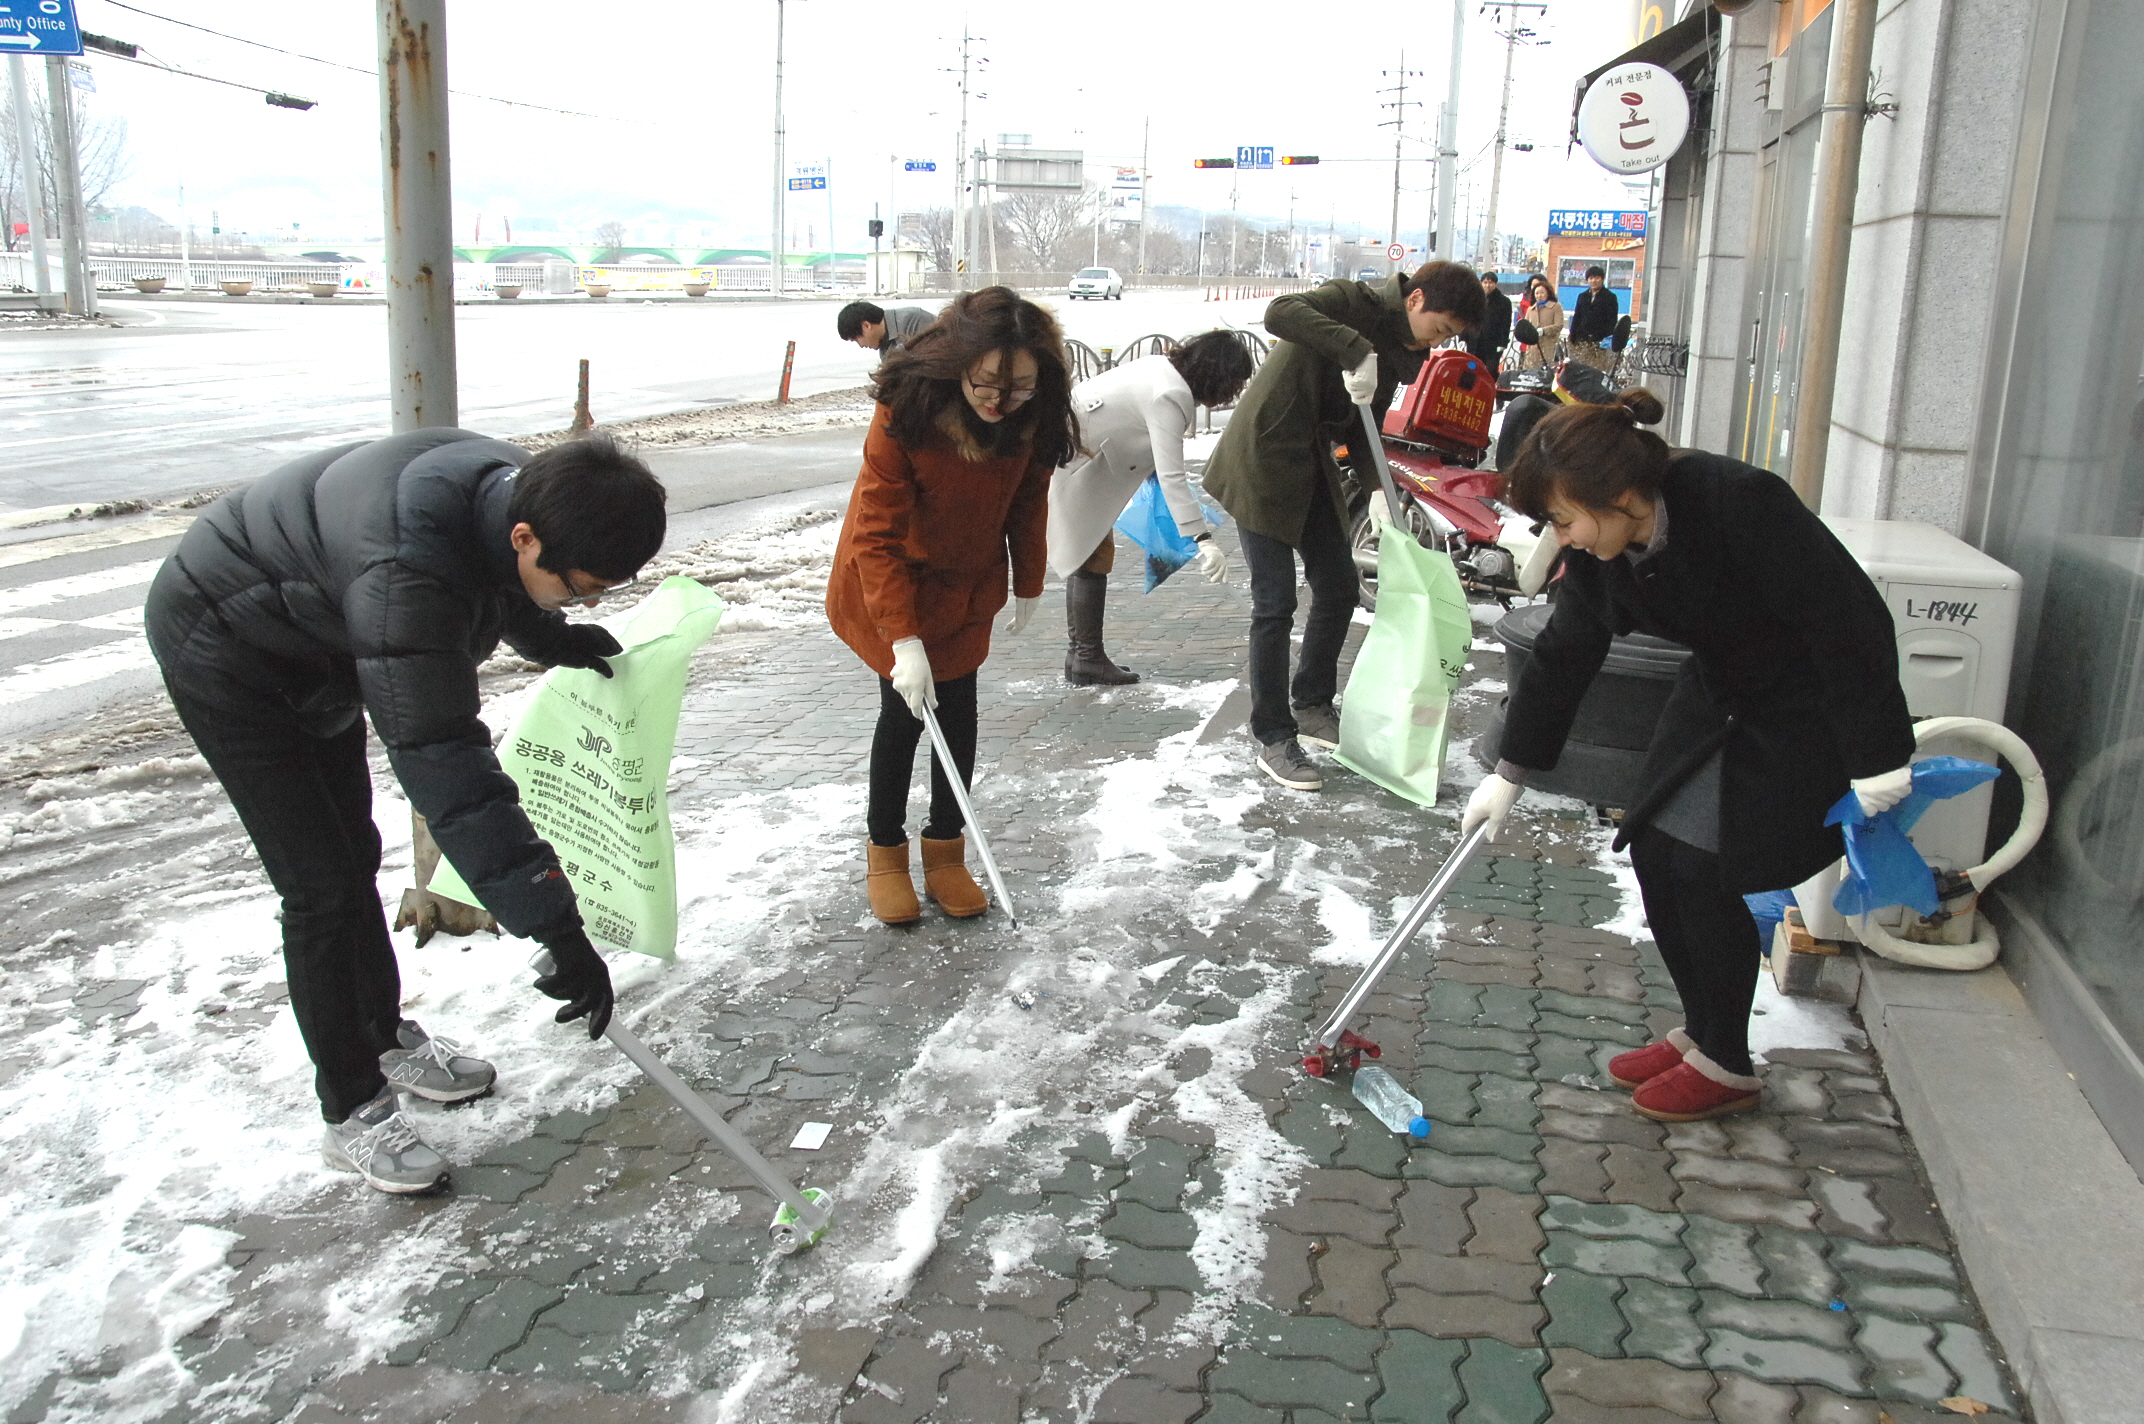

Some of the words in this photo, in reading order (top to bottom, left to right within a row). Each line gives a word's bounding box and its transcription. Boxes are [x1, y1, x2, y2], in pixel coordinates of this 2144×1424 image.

[27, 16, 66, 31] Office
[1605, 76, 1623, 87] 커피
[1625, 69, 1652, 84] 전문점
[1620, 157, 1642, 168] Take
[1645, 154, 1660, 165] out
[1391, 248, 1402, 257] 70
[1906, 598, 1979, 627] L-1844
[570, 691, 578, 701] 이
[516, 737, 566, 768] 공공용
[612, 756, 644, 776] 증평군
